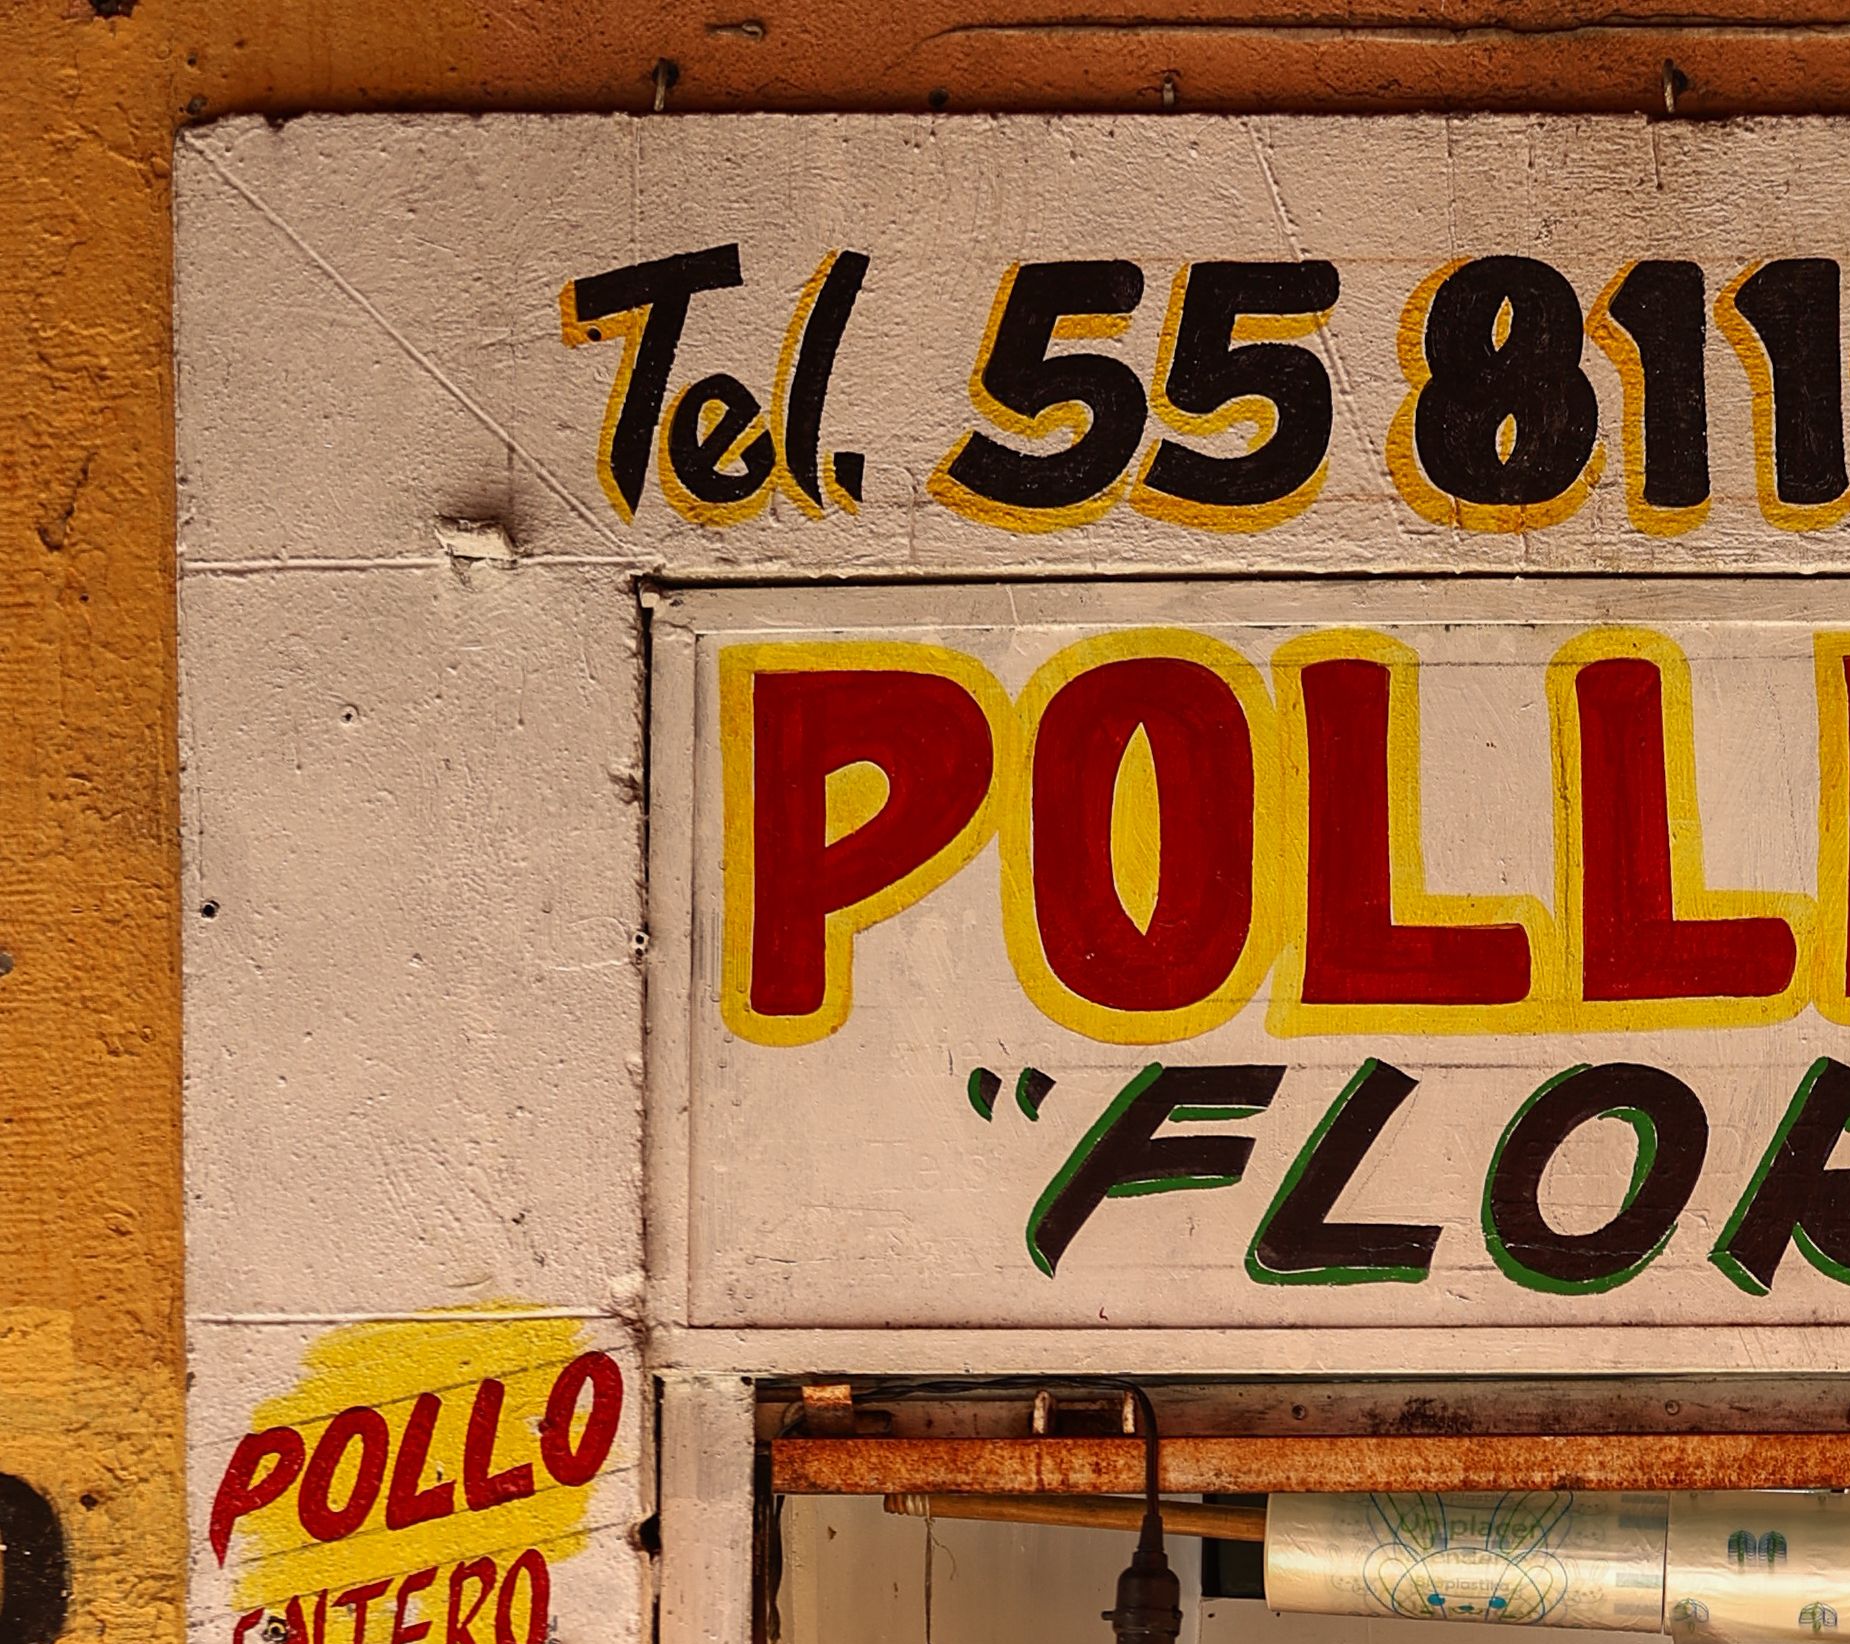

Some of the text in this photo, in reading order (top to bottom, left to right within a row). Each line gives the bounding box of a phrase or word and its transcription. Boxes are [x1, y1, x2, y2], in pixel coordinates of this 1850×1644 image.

[575, 244, 870, 514] Tel.
[945, 258, 1342, 510] 55
[209, 1349, 625, 1567] POLLO
